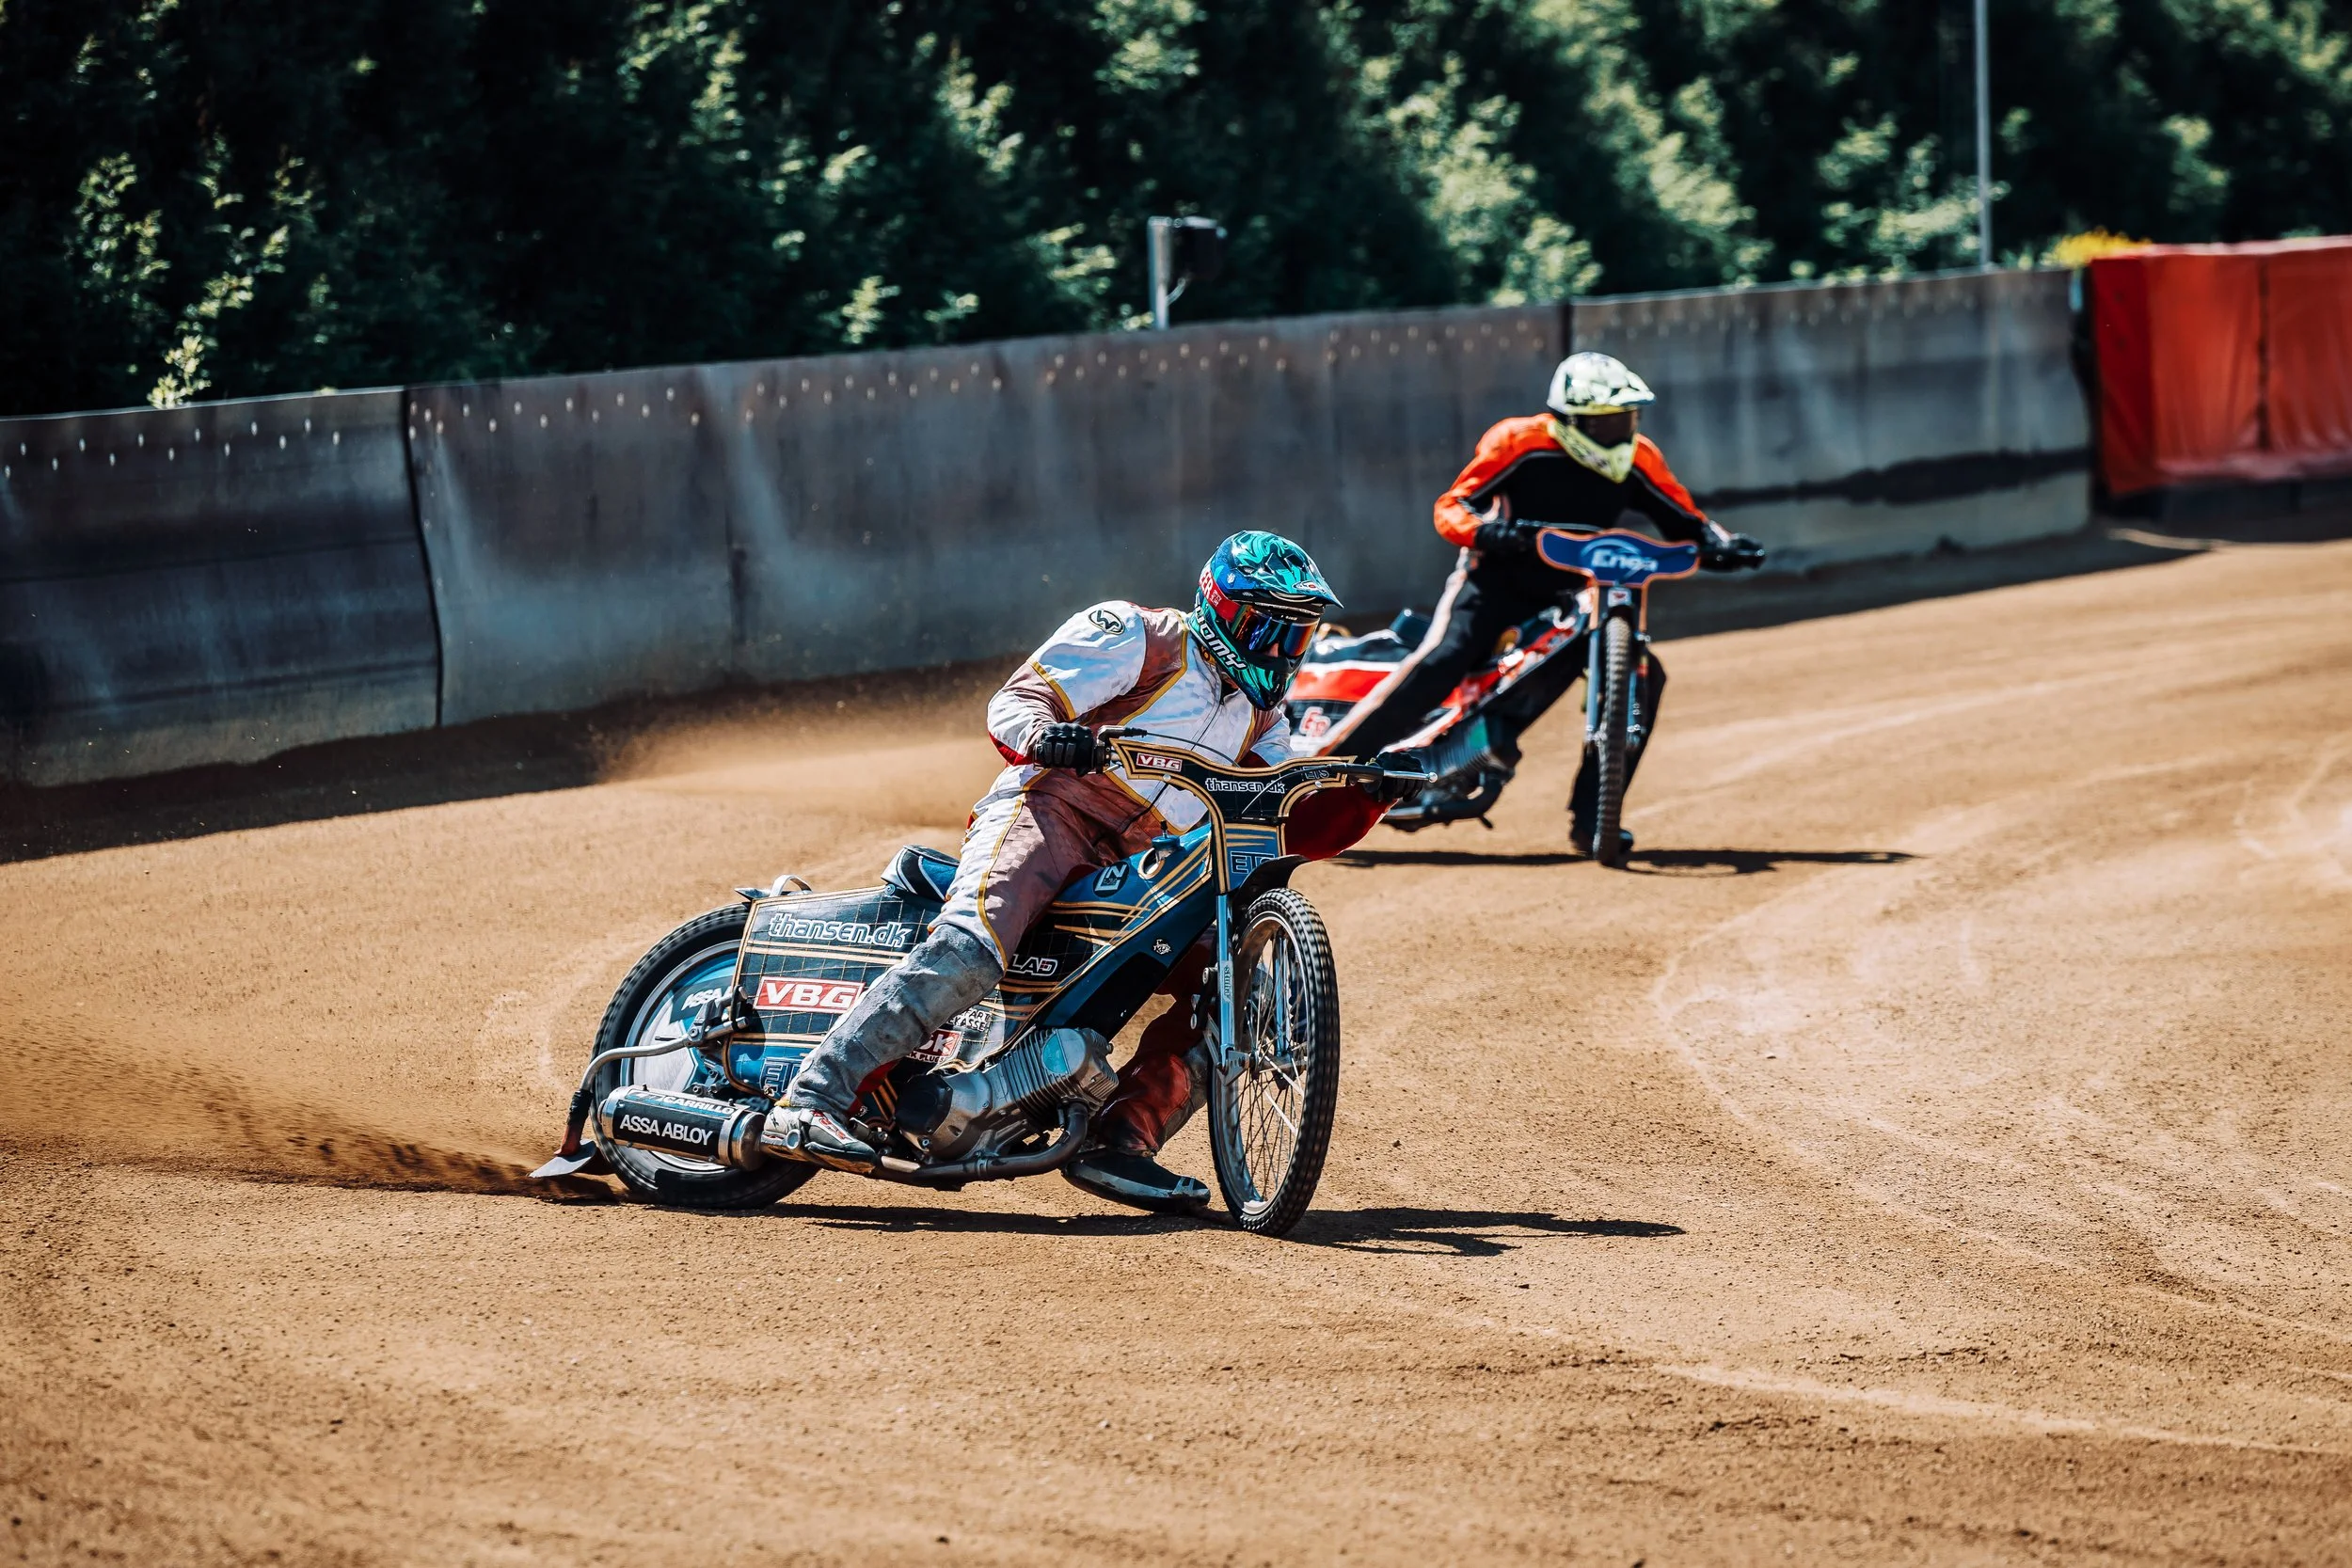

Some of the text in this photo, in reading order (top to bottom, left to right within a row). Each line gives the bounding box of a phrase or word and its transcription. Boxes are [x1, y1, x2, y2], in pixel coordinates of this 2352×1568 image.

[1139, 754, 1180, 769] VBG
[1205, 777, 1286, 794] thansendk
[1231, 850, 1276, 875] ET
[768, 912, 913, 948] thansen.dk
[766, 982, 857, 1008] VBG
[919, 1053, 945, 1063] PLUGS
[664, 1095, 735, 1115] CARRILLO
[620, 1114, 713, 1146] ASSA ABLOY
